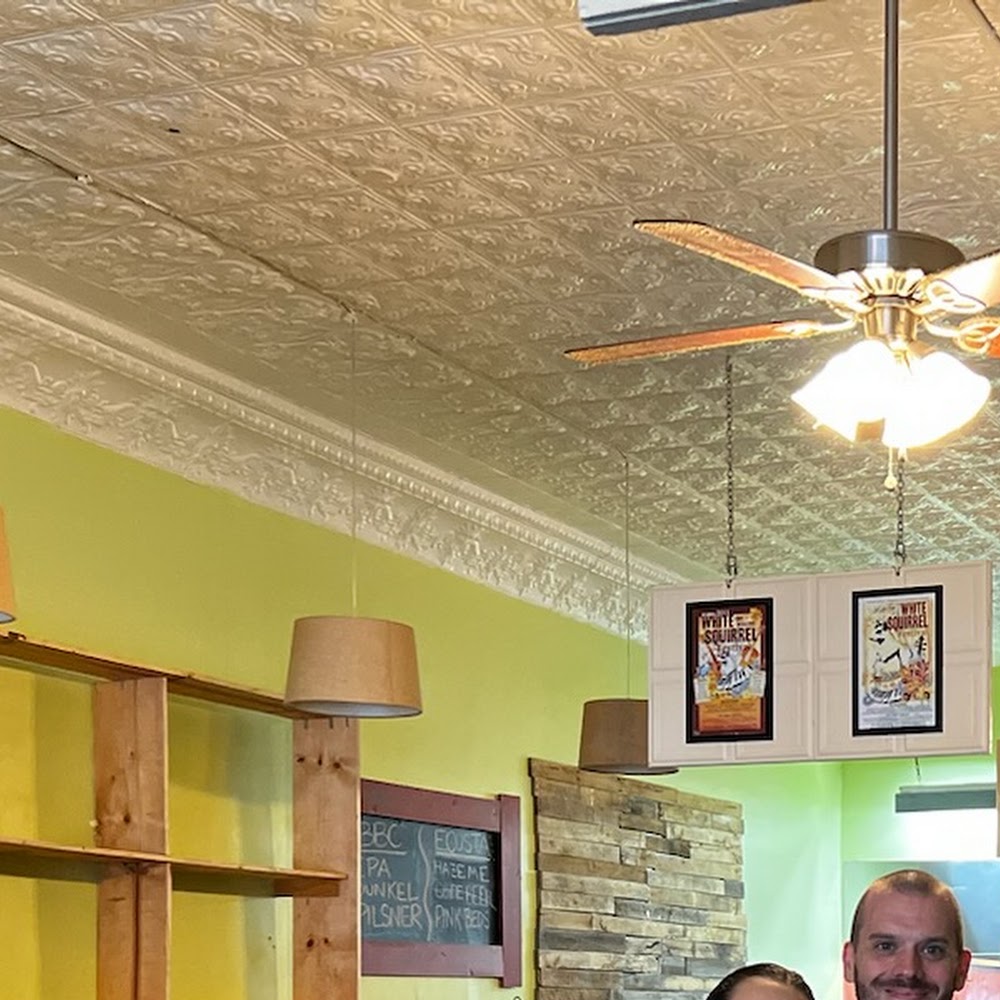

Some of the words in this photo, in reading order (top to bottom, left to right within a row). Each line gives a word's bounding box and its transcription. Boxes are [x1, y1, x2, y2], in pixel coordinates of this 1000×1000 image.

[901, 601, 927, 615] WHITE
[702, 616, 733, 630] WHITE
[887, 614, 929, 632] SQUIRREL
[703, 627, 758, 645] SQUIRREL
[361, 856, 392, 879] PA
[467, 865, 490, 884] ME
[361, 880, 420, 902] UNKEL
[434, 904, 463, 932] PINK
